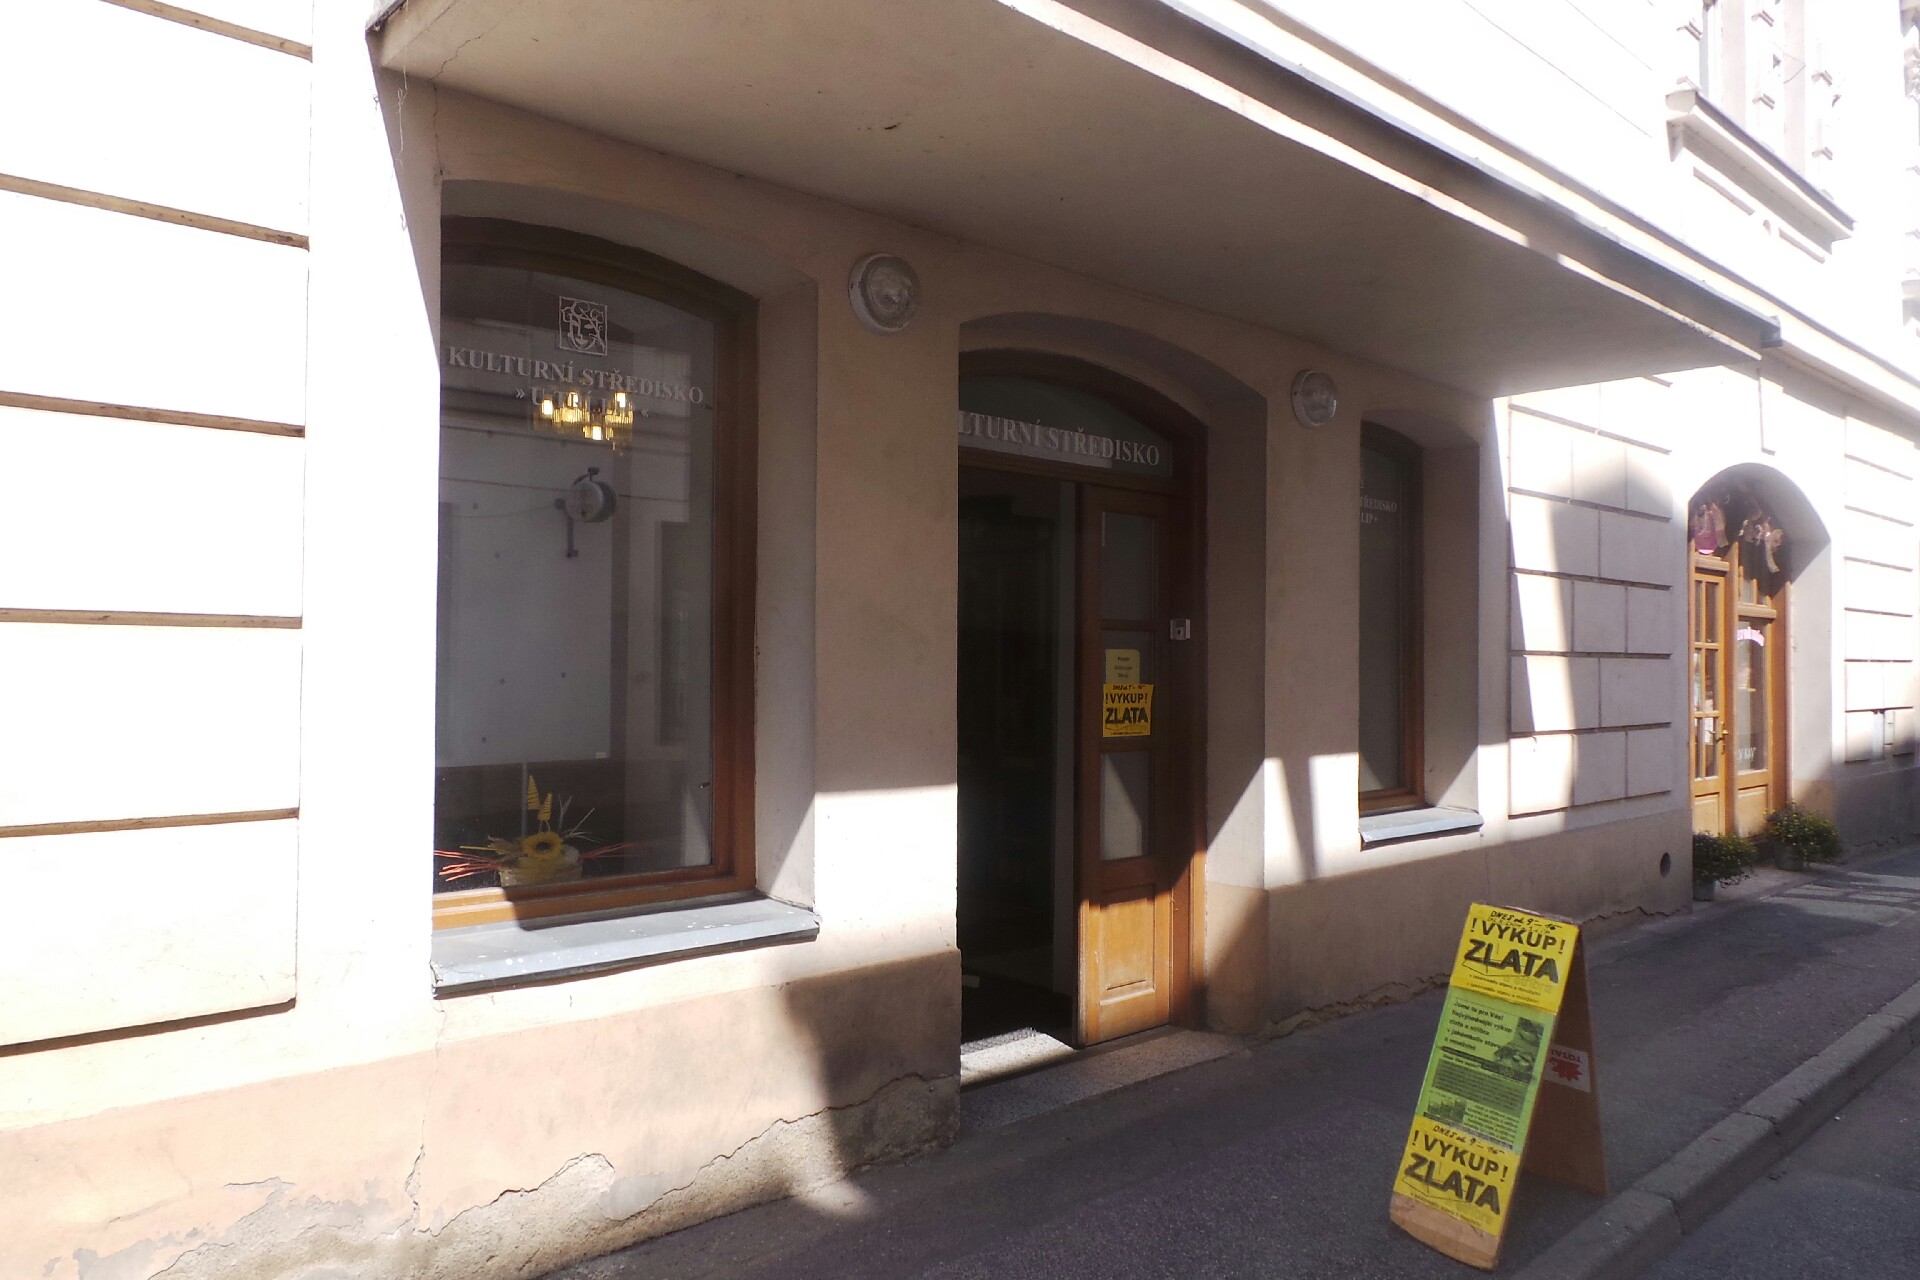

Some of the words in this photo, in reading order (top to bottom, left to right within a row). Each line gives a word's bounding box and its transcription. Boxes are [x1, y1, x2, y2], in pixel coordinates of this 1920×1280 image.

[448, 346, 574, 383] KULTURNÍ
[582, 368, 704, 404] STŘEDISKO
[1048, 426, 1161, 466] STŘEDISKO
[1104, 707, 1149, 724] ZLATA
[1490, 910, 1515, 921] DNES
[1463, 939, 1559, 984] ZLATA
[1432, 1124, 1458, 1138] DNES
[1403, 1152, 1501, 1216] ZLATA
